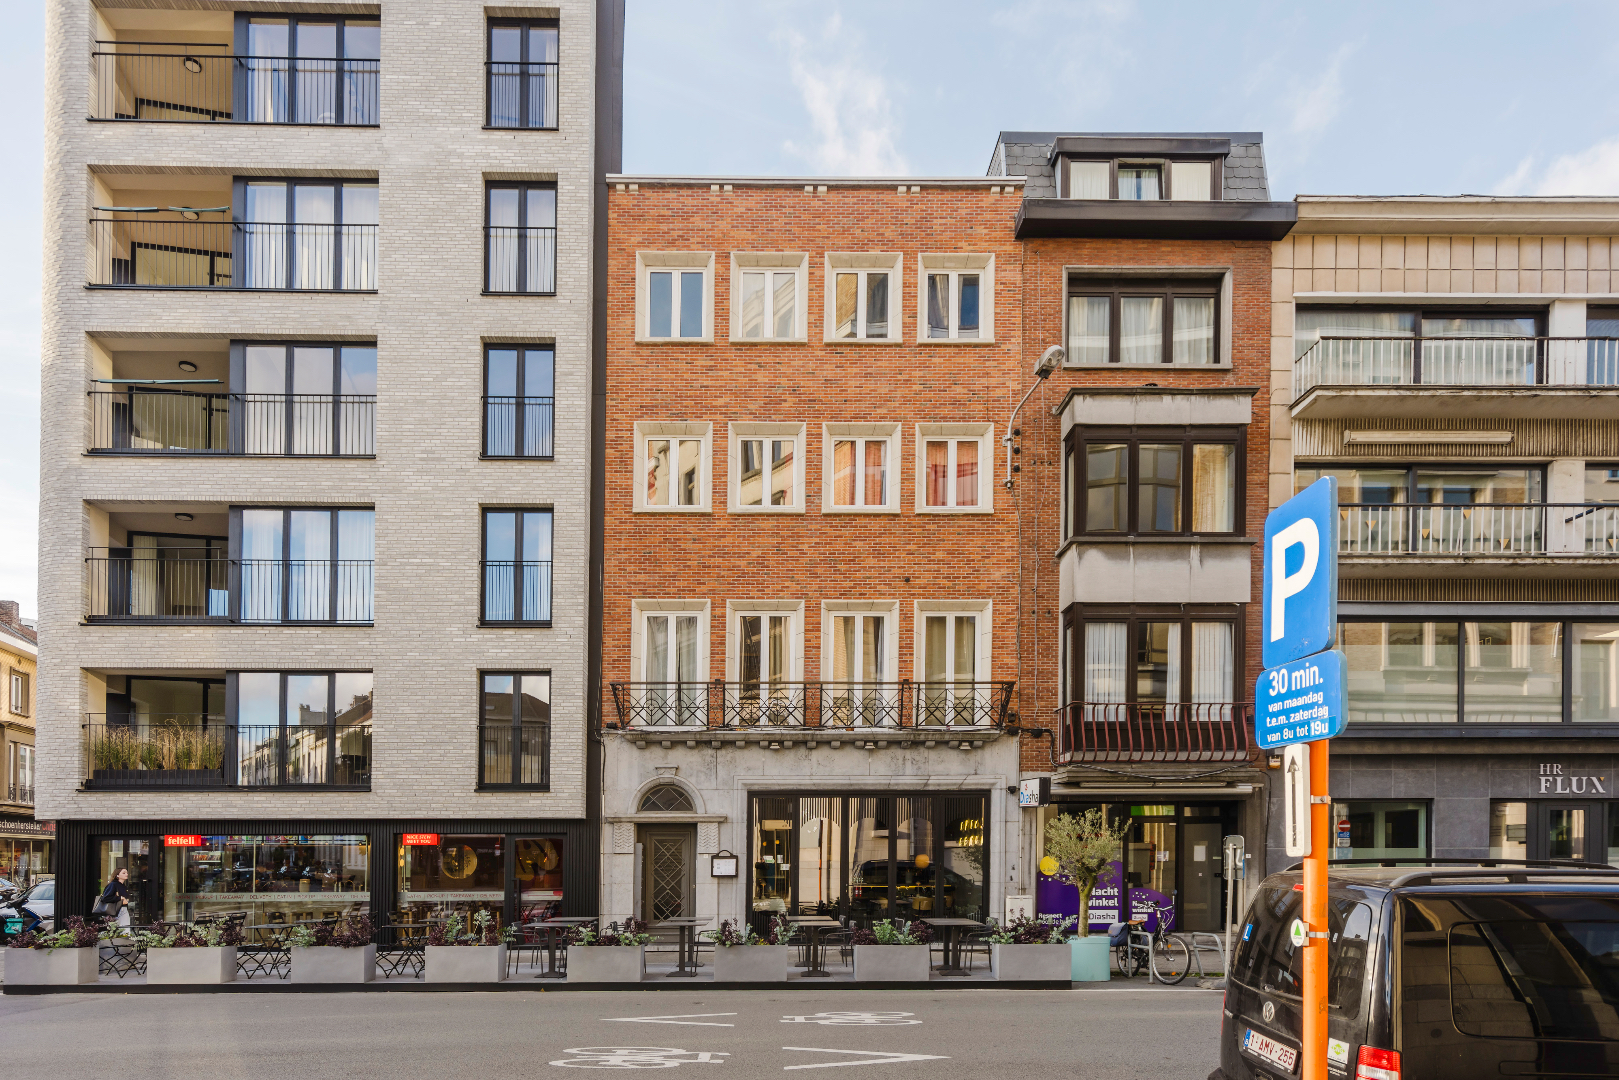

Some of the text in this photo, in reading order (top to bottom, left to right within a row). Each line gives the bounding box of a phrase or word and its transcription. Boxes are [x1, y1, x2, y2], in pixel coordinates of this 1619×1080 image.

[1271, 518, 1319, 642] P
[1269, 662, 1323, 696] 30 min.
[1268, 691, 1323, 712] van maandag
[1266, 705, 1328, 727] t.e.m. zaterdag
[1267, 721, 1328, 742] van 8u tot 19u
[1539, 763, 1563, 774] HR
[1539, 777, 1606, 793] FLUX
[1020, 790, 1038, 803] Diasha
[168, 836, 194, 845] felfeli
